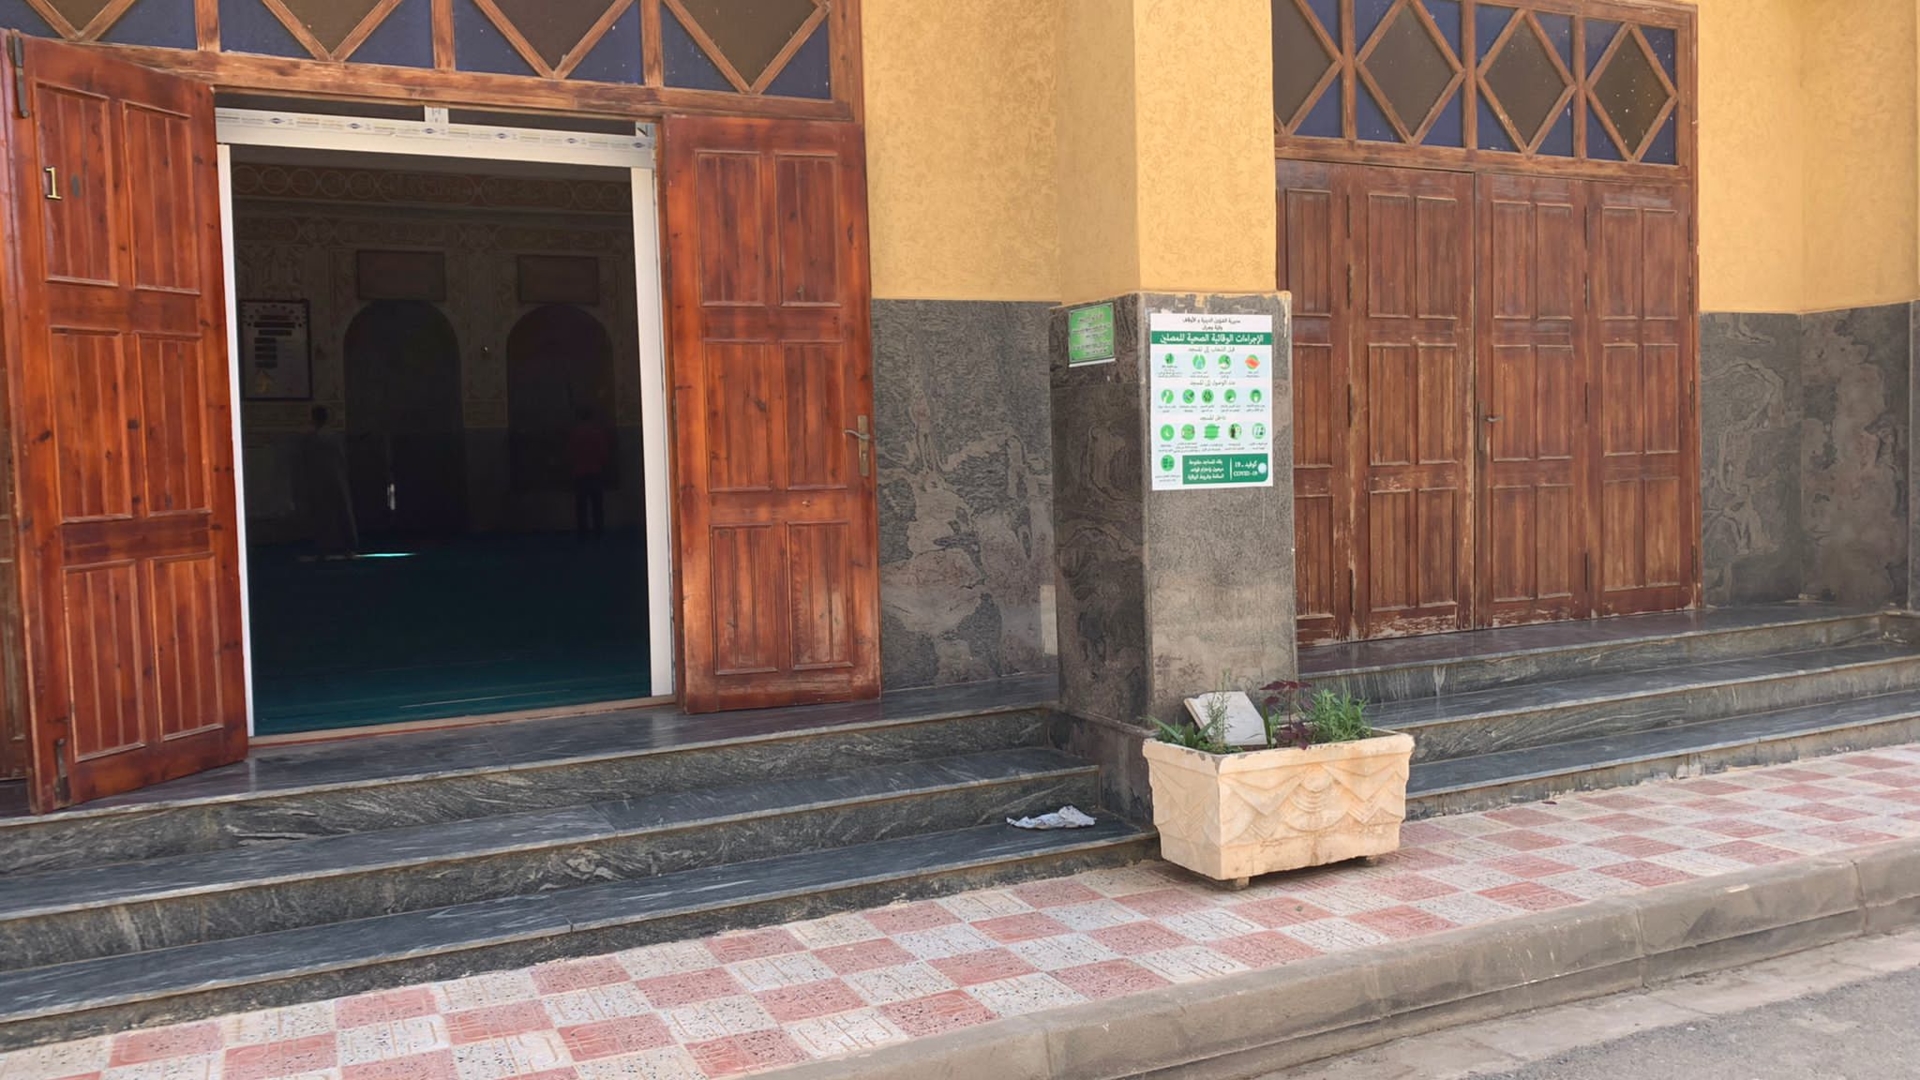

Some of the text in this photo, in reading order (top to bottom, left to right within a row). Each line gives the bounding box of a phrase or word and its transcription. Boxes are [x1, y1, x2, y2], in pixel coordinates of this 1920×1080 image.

[1160, 332, 1264, 345] الإجراءات الوقائية الصحية للمصلين
